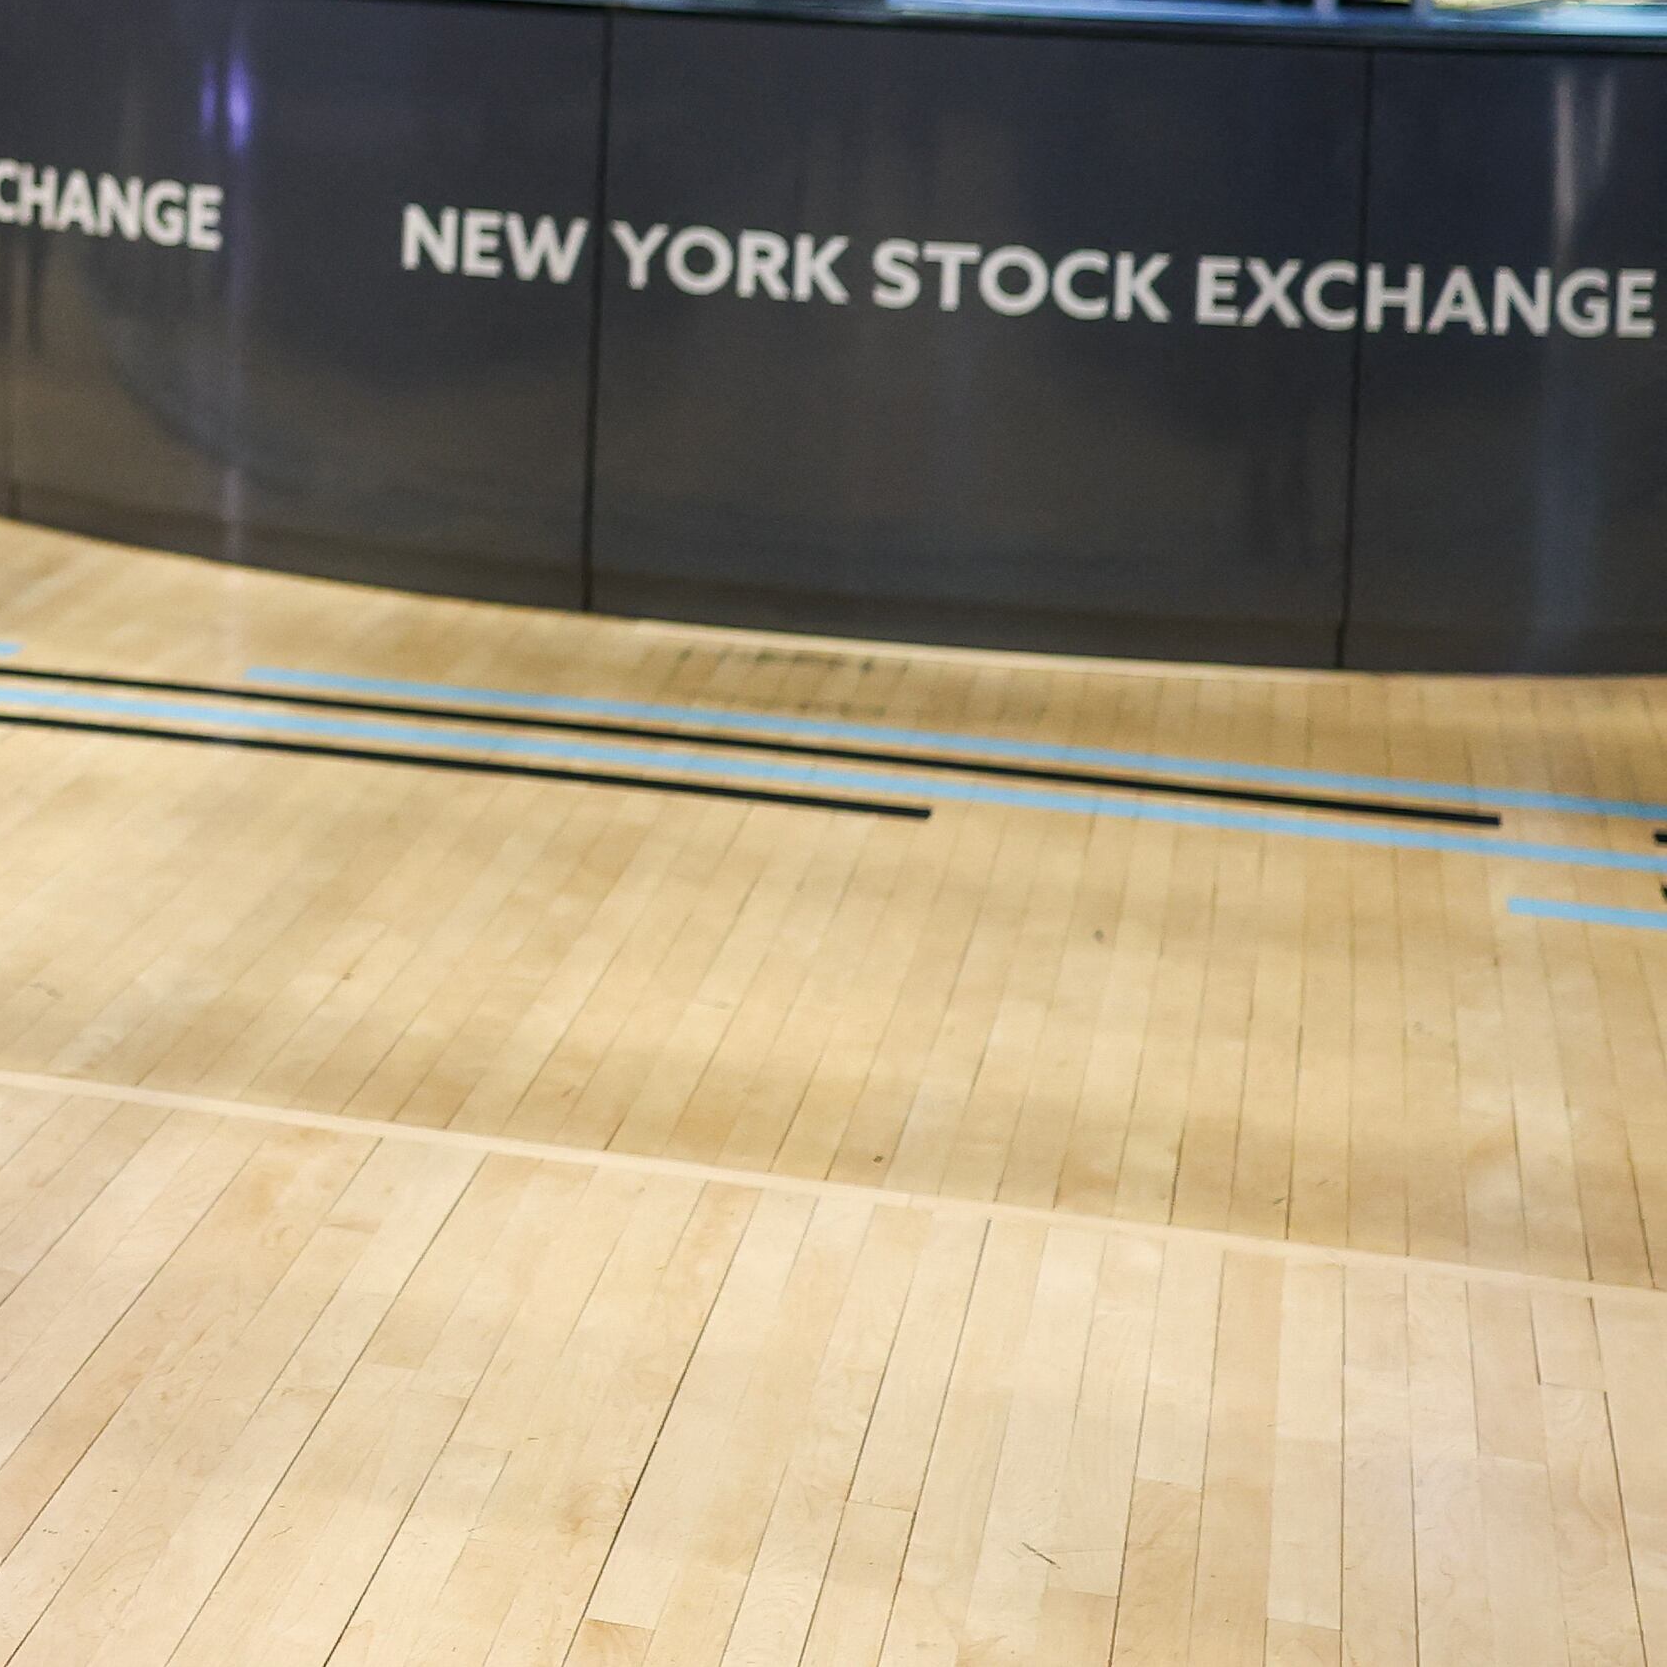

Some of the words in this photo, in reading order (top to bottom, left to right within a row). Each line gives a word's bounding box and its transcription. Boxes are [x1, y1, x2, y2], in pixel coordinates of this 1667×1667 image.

[400, 203, 588, 284] NEW
[611, 221, 850, 304] YORK
[872, 239, 1172, 323] STOCK
[1196, 256, 1658, 338] EXCHANGE
